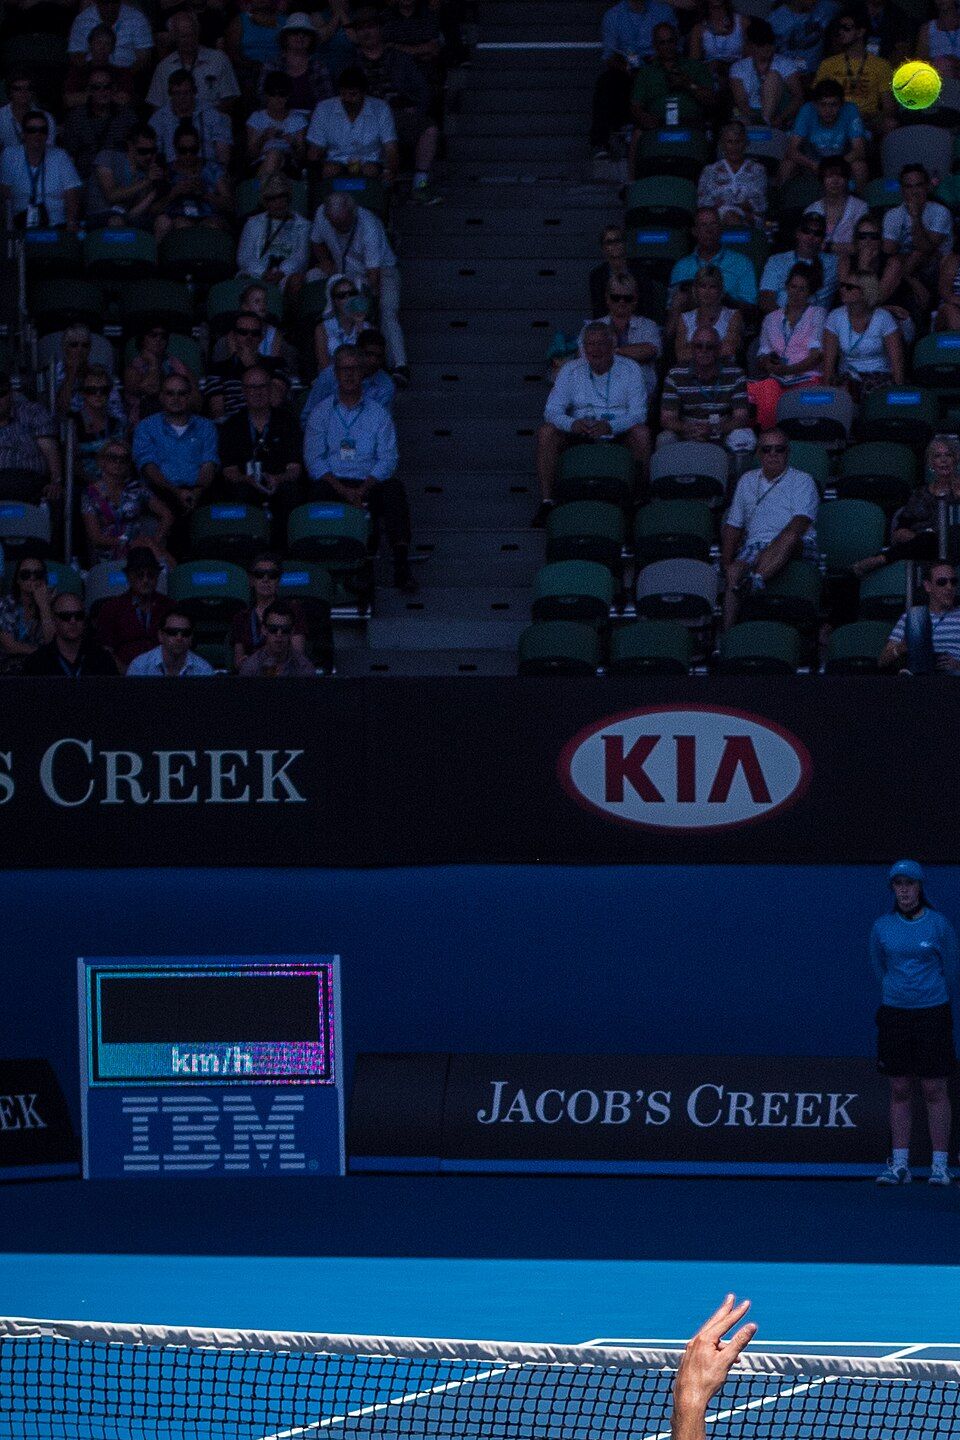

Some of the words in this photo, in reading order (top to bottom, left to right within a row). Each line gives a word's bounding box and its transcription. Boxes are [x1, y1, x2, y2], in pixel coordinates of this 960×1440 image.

[39, 738, 307, 807] CREEK
[601, 734, 773, 803] KIA
[171, 1046, 253, 1074] km/h
[122, 1095, 306, 1170] IBM
[686, 1083, 859, 1127] CREEK
